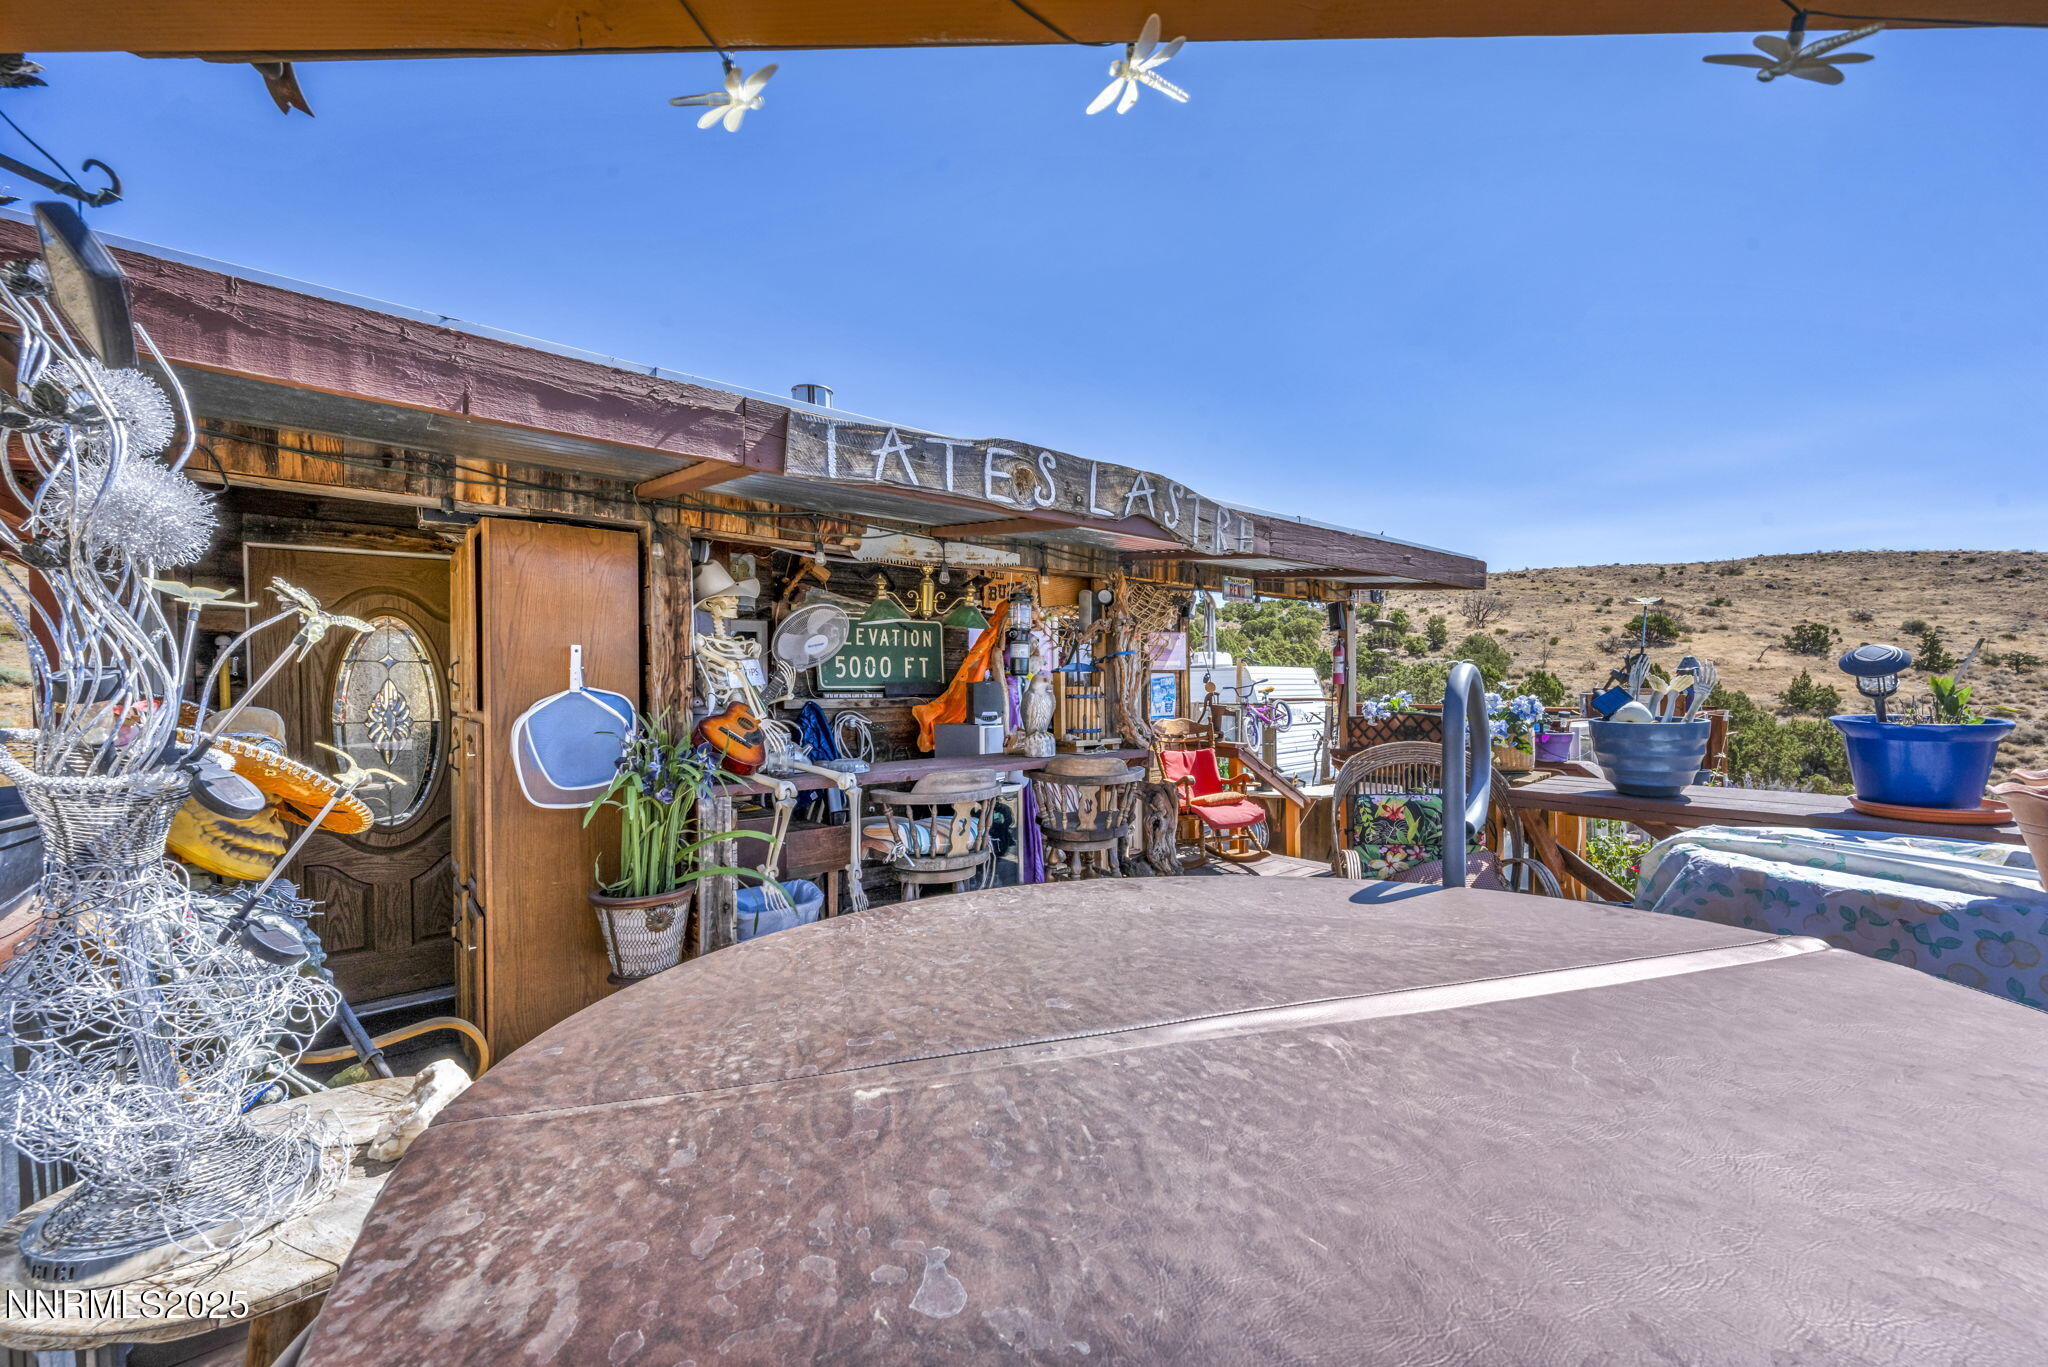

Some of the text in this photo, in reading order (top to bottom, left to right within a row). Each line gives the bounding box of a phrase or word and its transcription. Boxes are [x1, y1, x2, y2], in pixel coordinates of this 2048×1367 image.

[1090, 460, 1207, 545] LAST
[835, 655, 929, 679] 5000 FT
